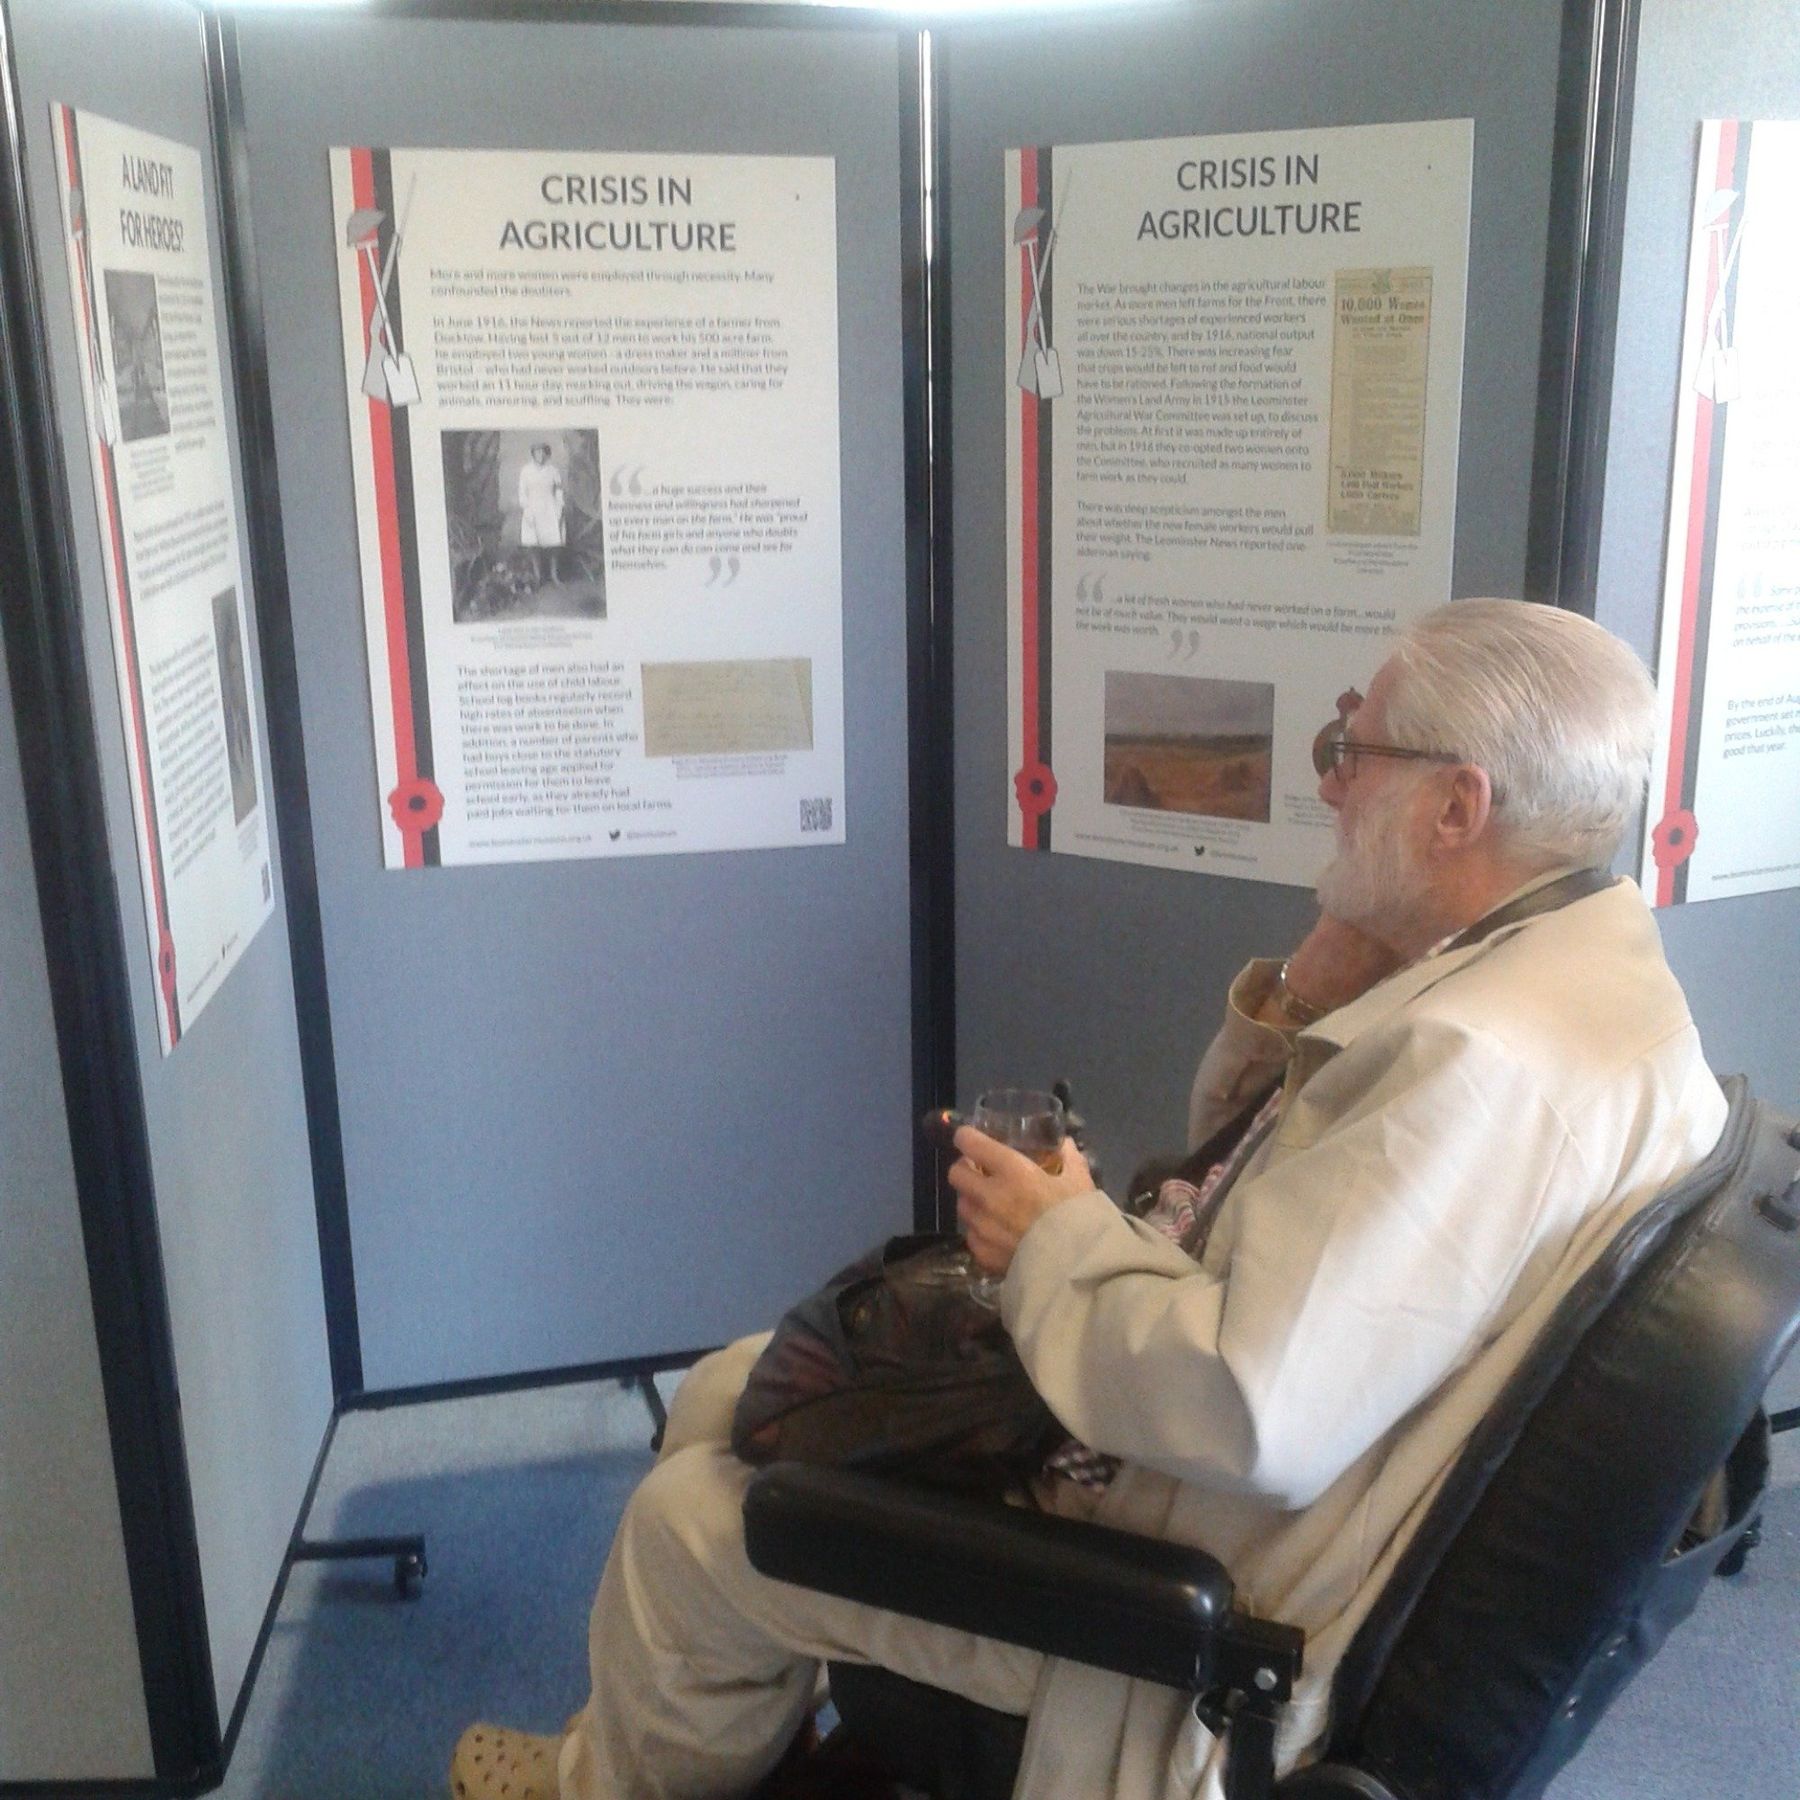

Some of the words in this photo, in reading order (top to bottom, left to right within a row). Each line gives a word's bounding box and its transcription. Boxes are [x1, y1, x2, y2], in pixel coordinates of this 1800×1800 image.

[123, 154, 131, 189] A
[130, 155, 159, 197] LAND
[159, 162, 174, 200] FIT
[1177, 156, 1276, 191] CRISIS
[1285, 154, 1319, 186] IN
[541, 175, 649, 205] CRISIS
[658, 176, 692, 206] IN
[1137, 201, 1362, 240] AGRICULTURE
[120, 208, 144, 248] FOR
[143, 213, 184, 253] HEROES?
[500, 220, 737, 251] AGRICULTURE
[430, 269, 461, 280] More
[486, 272, 516, 280] more
[518, 272, 559, 280] women
[561, 272, 588, 280] were
[590, 270, 644, 284] employed
[646, 270, 690, 284] through
[691, 270, 741, 284] necessity.
[744, 270, 774, 285] Many
[1078, 284, 1094, 294] The
[1096, 284, 1117, 294] War
[1119, 283, 1157, 297] brought
[1159, 282, 1199, 296] changes
[1212, 281, 1229, 292] the
[1232, 280, 1290, 294] agricultural
[1292, 279, 1326, 290] labour
[1128, 301, 1154, 309] more
[1178, 298, 1195, 308] left
[1197, 297, 1226, 308] farms
[1298, 295, 1326, 306] there
[1342, 297, 1382, 313] 10,000
[448, 317, 473, 328] June
[530, 317, 562, 328] News
[563, 317, 612, 332] reported
[634, 317, 693, 332] experience
[716, 317, 752, 328] farmer
[754, 317, 780, 328] from
[1078, 318, 1100, 326] were
[1102, 315, 1136, 326] serious
[1138, 314, 1186, 328] shortages
[1200, 313, 1261, 327] experienced
[1262, 312, 1306, 324] workers
[1090, 333, 1110, 341] over
[1236, 330, 1278, 340] national
[1280, 329, 1314, 344] output
[1097, 347, 1124, 357] down
[1168, 346, 1195, 357] There
[1218, 345, 1270, 360] increasing
[1096, 365, 1123, 376] crops
[1124, 362, 1154, 373] would
[1239, 362, 1262, 372] food
[1264, 361, 1296, 372] would
[1170, 378, 1218, 391] Following
[1238, 378, 1288, 388] formation
[1139, 394, 1162, 405] Land
[1164, 394, 1191, 408] Army
[1250, 395, 1308, 406] Leominster
[1077, 410, 1132, 423] Agricultural
[1156, 410, 1210, 421] Committee
[1281, 411, 1318, 422] discuss
[1206, 427, 1234, 437] made
[1250, 427, 1290, 441] entirely
[1155, 442, 1177, 455] they
[1246, 446, 1284, 455] women
[1285, 445, 1310, 455] onto
[1171, 458, 1217, 469] recruited
[1232, 461, 1258, 472] many
[1260, 462, 1298, 470] women
[1099, 472, 1124, 483] work
[1077, 502, 1104, 512] There
[1125, 503, 1148, 517] deep
[1150, 504, 1200, 518] scepticism
[1202, 505, 1244, 519] amongst
[1264, 509, 1286, 518] men
[1077, 518, 1102, 528] about
[1104, 518, 1142, 530] whether
[1184, 521, 1218, 533] female
[1220, 523, 1260, 534] workers
[1261, 524, 1292, 535] would
[1076, 531, 1098, 542] their
[1154, 535, 1208, 547] Leominster
[1210, 537, 1238, 548] News
[1240, 538, 1284, 553] reported
[1077, 546, 1118, 558] alderman
[1171, 599, 1204, 609] women
[1246, 603, 1272, 613] never
[1274, 603, 1310, 615] worked
[1113, 608, 1138, 619] much
[1190, 612, 1218, 624] would
[1219, 614, 1244, 625] want
[1252, 618, 1278, 630] wage
[1279, 617, 1308, 629] which
[1308, 619, 1339, 631] would
[1354, 624, 1380, 633] more
[1728, 699, 1739, 712] By
[1740, 698, 1755, 710] the
[1757, 697, 1774, 708] end
[1775, 694, 1784, 707] of
[1726, 711, 1779, 728] government
[1780, 710, 1793, 721] set
[1723, 745, 1746, 760] good
[1747, 744, 1765, 756] that
